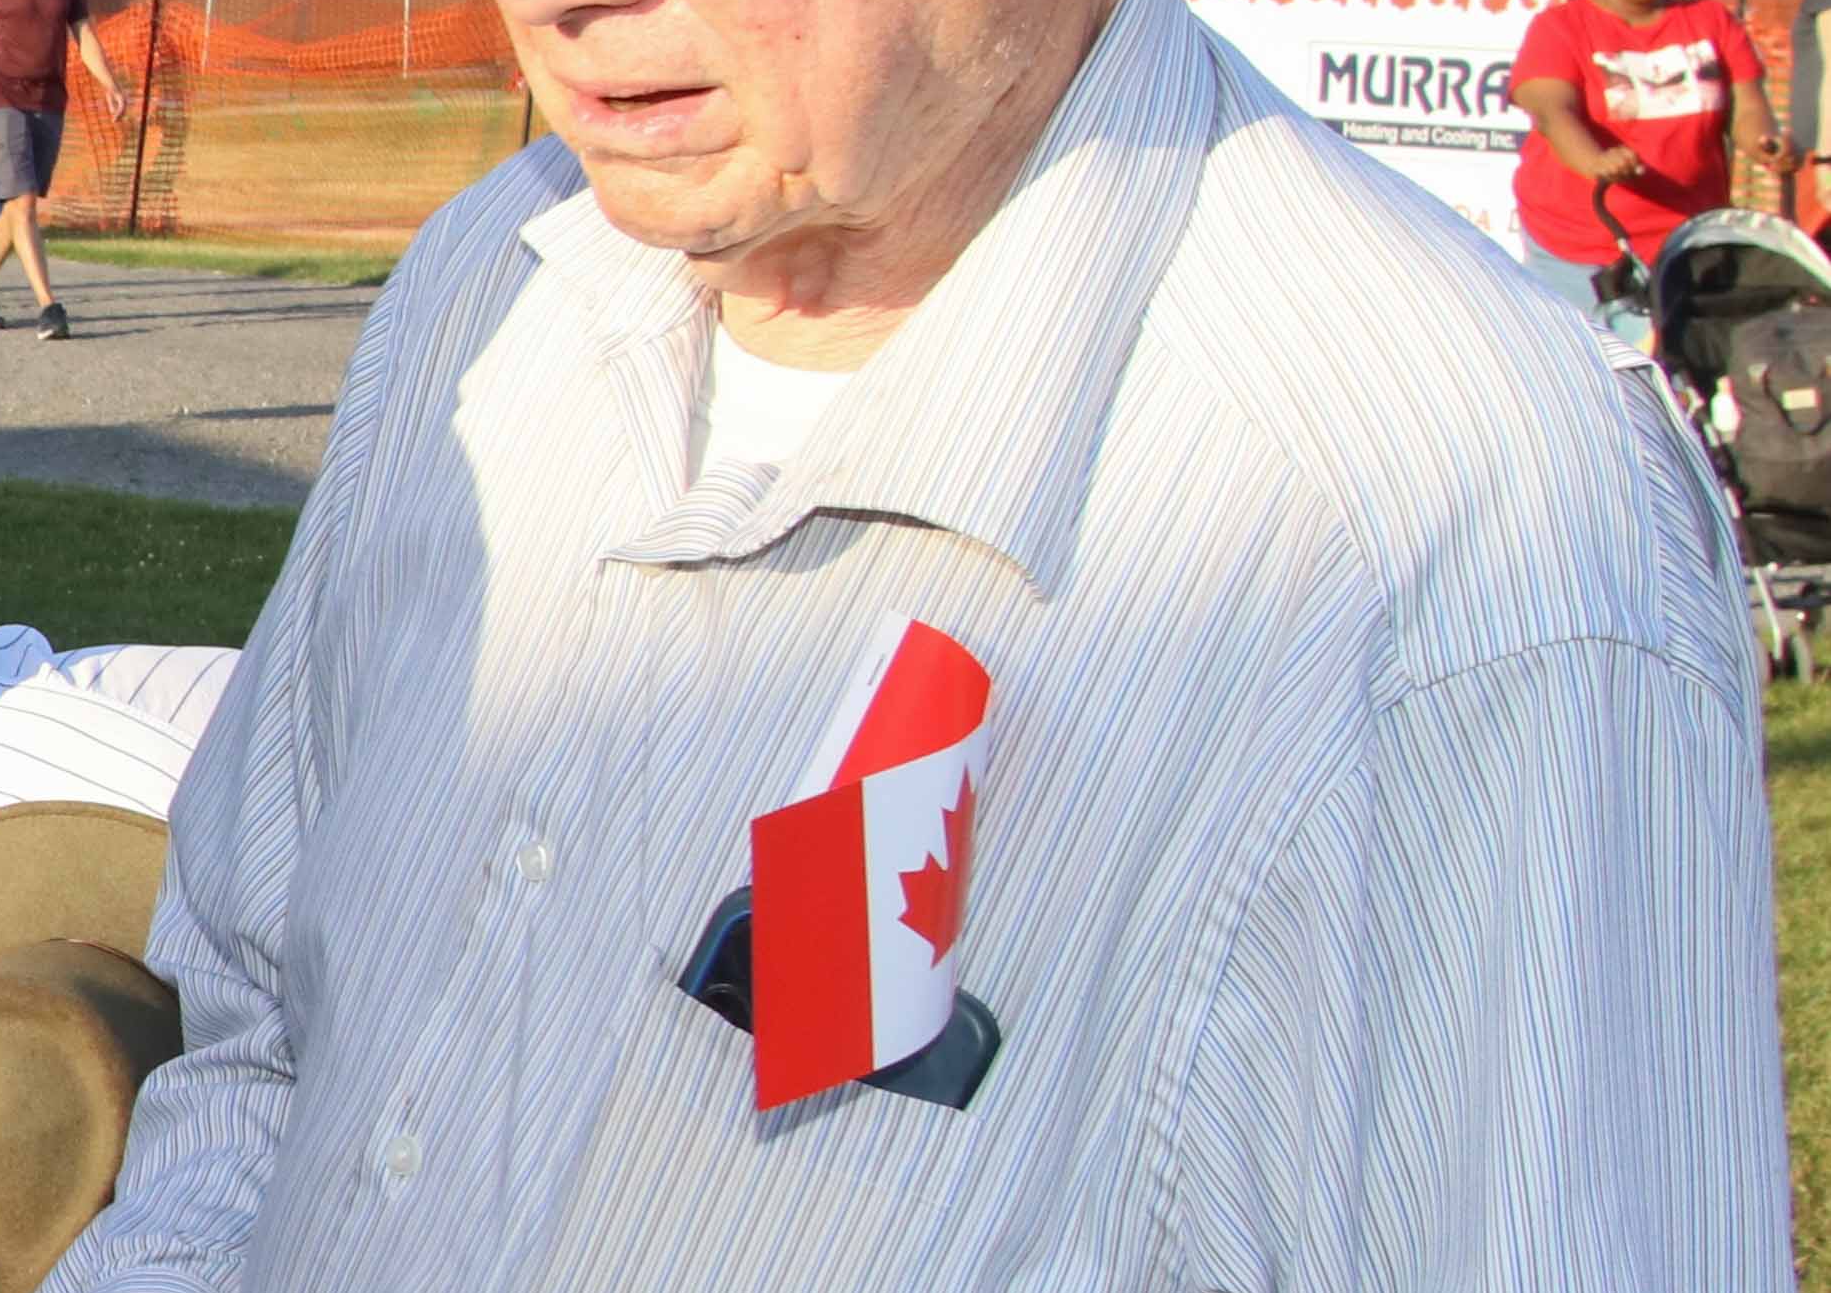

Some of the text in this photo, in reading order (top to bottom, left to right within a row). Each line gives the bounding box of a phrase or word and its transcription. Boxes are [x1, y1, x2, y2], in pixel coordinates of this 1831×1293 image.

[1342, 120, 1517, 151] Heating and Cooling Inc.
